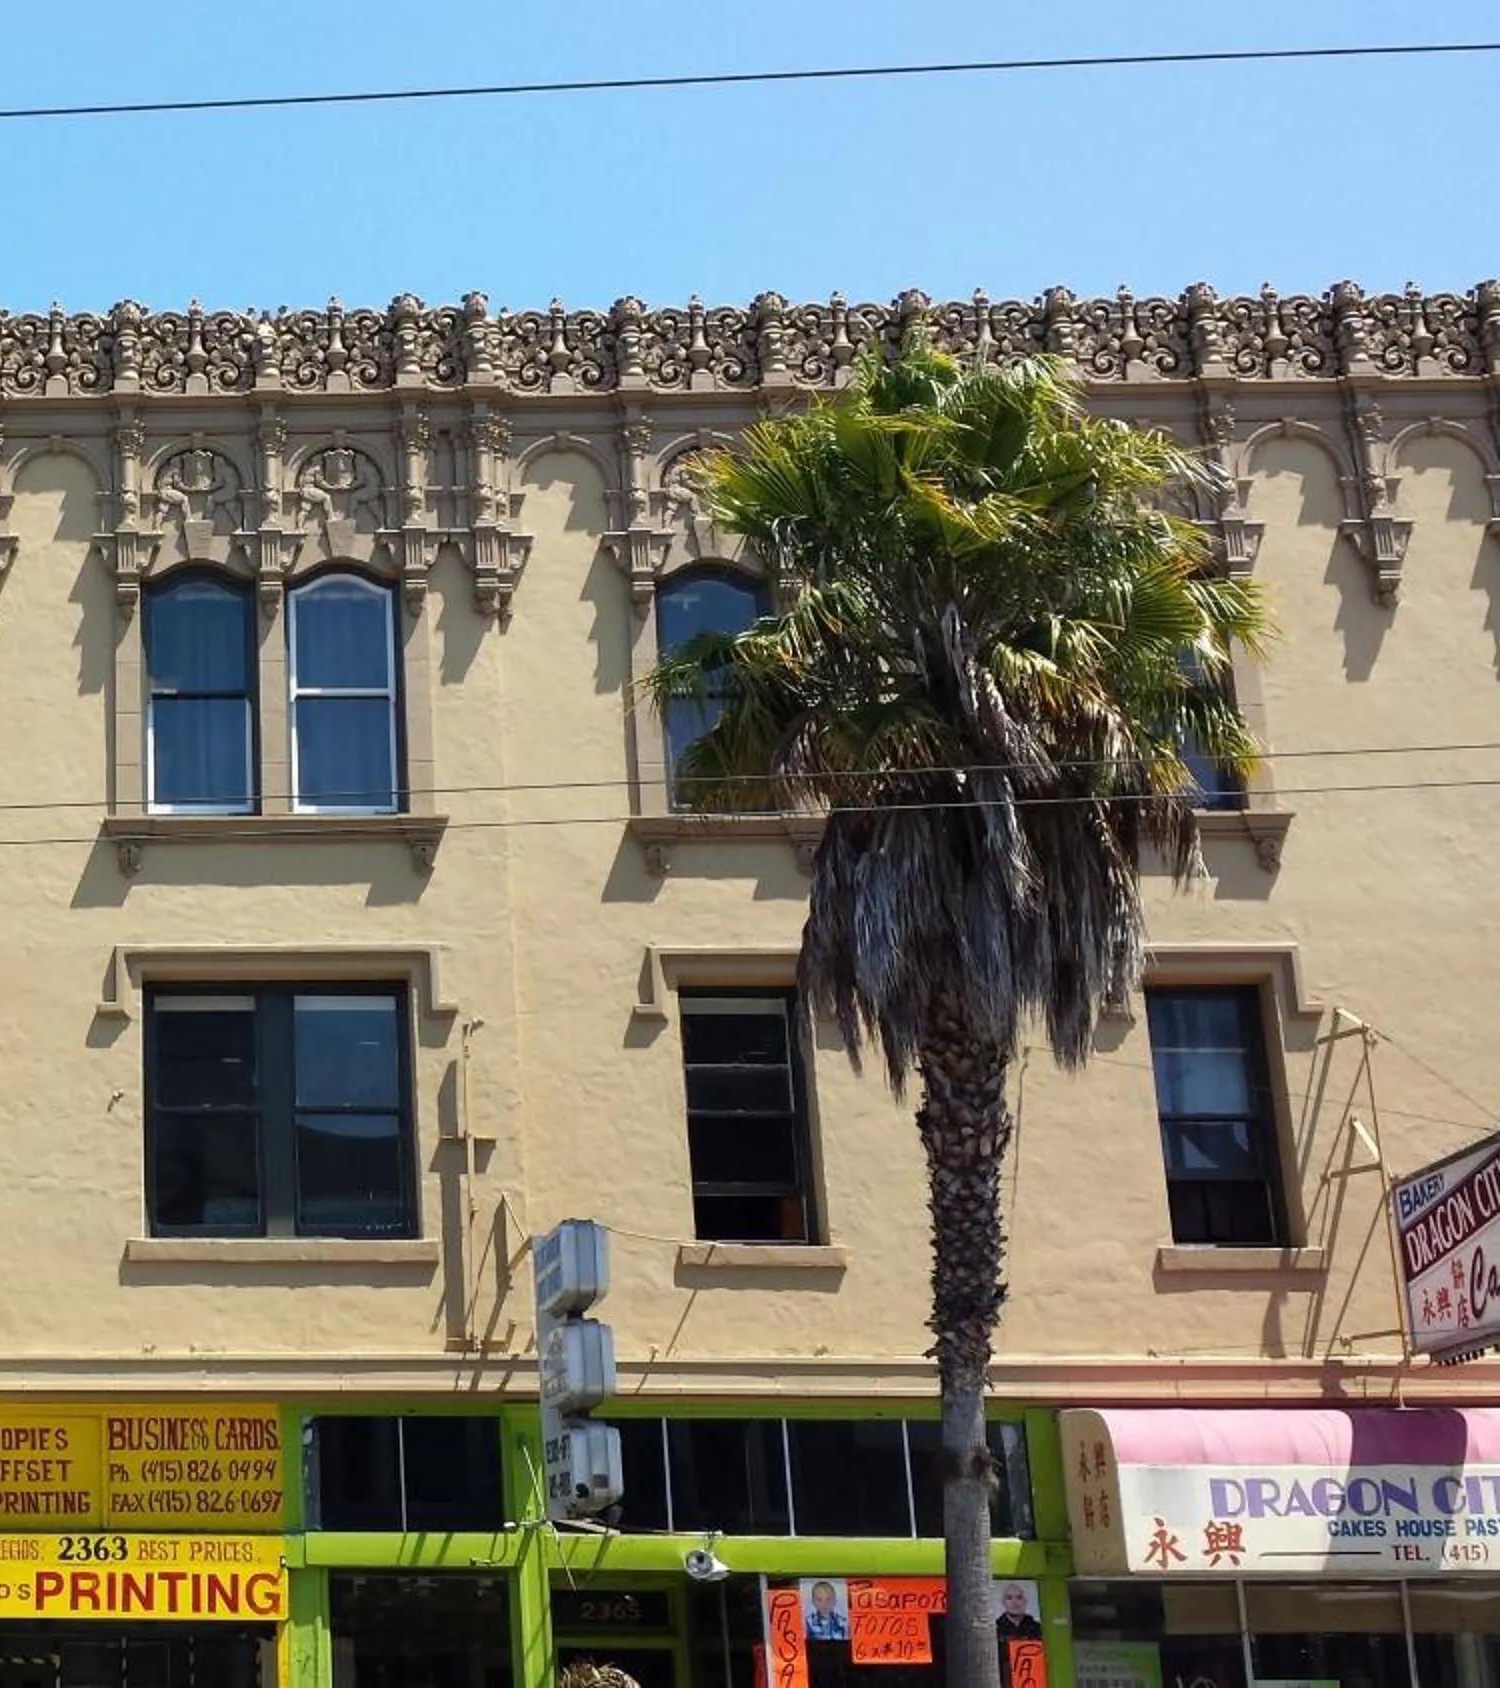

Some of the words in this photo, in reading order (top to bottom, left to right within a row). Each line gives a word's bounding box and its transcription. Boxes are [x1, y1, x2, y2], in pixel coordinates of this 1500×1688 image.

[1406, 1187, 1475, 1272] DRAGON
[1473, 1157, 1500, 1217] CIT
[108, 1417, 209, 1450] BUSINESS
[141, 1460, 183, 1482] (415)
[187, 1460, 222, 1482] 826
[229, 1460, 277, 1482] 0494
[111, 1493, 145, 1512] FAX
[148, 1491, 191, 1513] (415)
[1210, 1477, 1418, 1516] DRAGON
[1328, 1520, 1386, 1536] CAKES
[1396, 1520, 1456, 1536] HOUSE
[58, 1536, 128, 1562] 2363
[138, 1541, 180, 1561] BEST
[1144, 1517, 1246, 1570] 永興
[1392, 1544, 1430, 1561] TEL.
[1442, 1541, 1489, 1563] (415)
[35, 1571, 281, 1615] PRINTING
